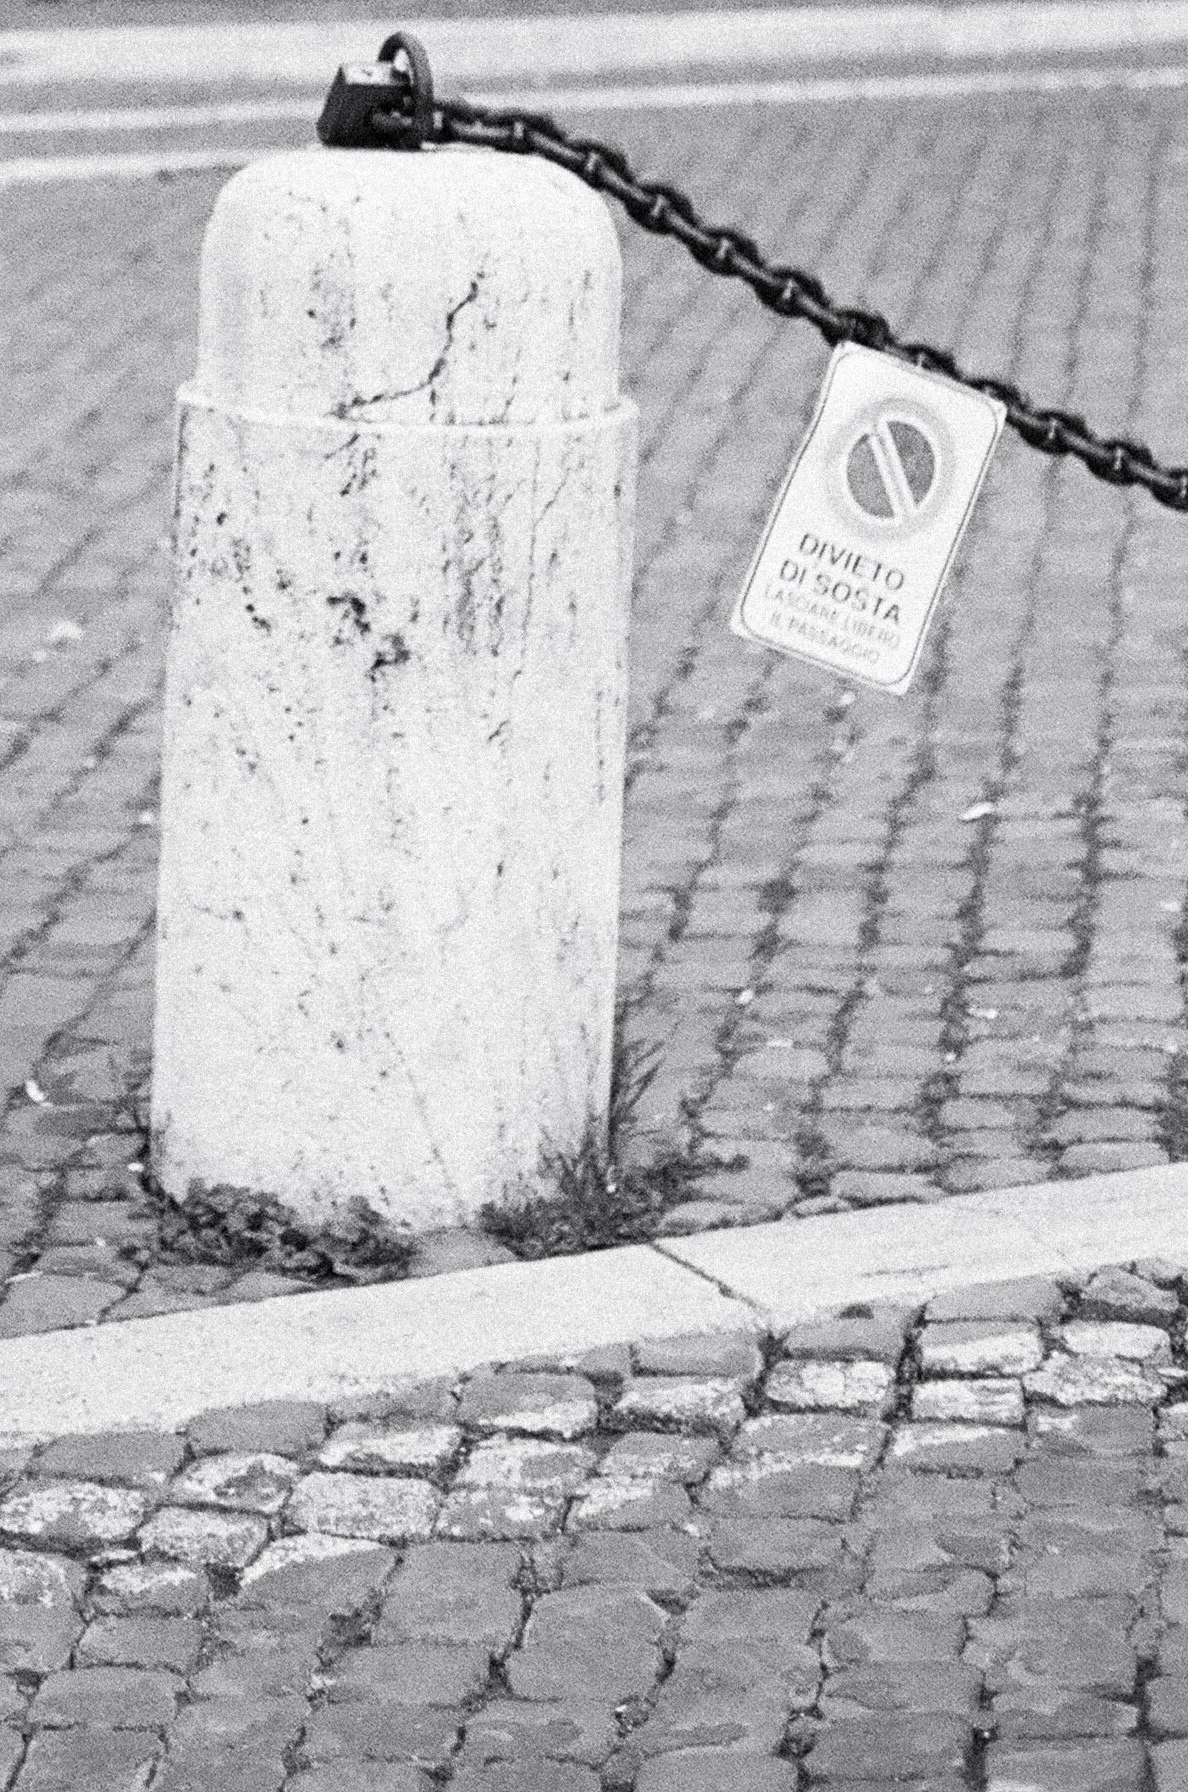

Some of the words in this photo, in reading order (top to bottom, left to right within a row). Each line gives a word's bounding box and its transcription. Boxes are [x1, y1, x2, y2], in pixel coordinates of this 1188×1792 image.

[780, 560, 807, 585] DI
[813, 573, 901, 625] SOSTA
[799, 533, 905, 591] DIVIETO
